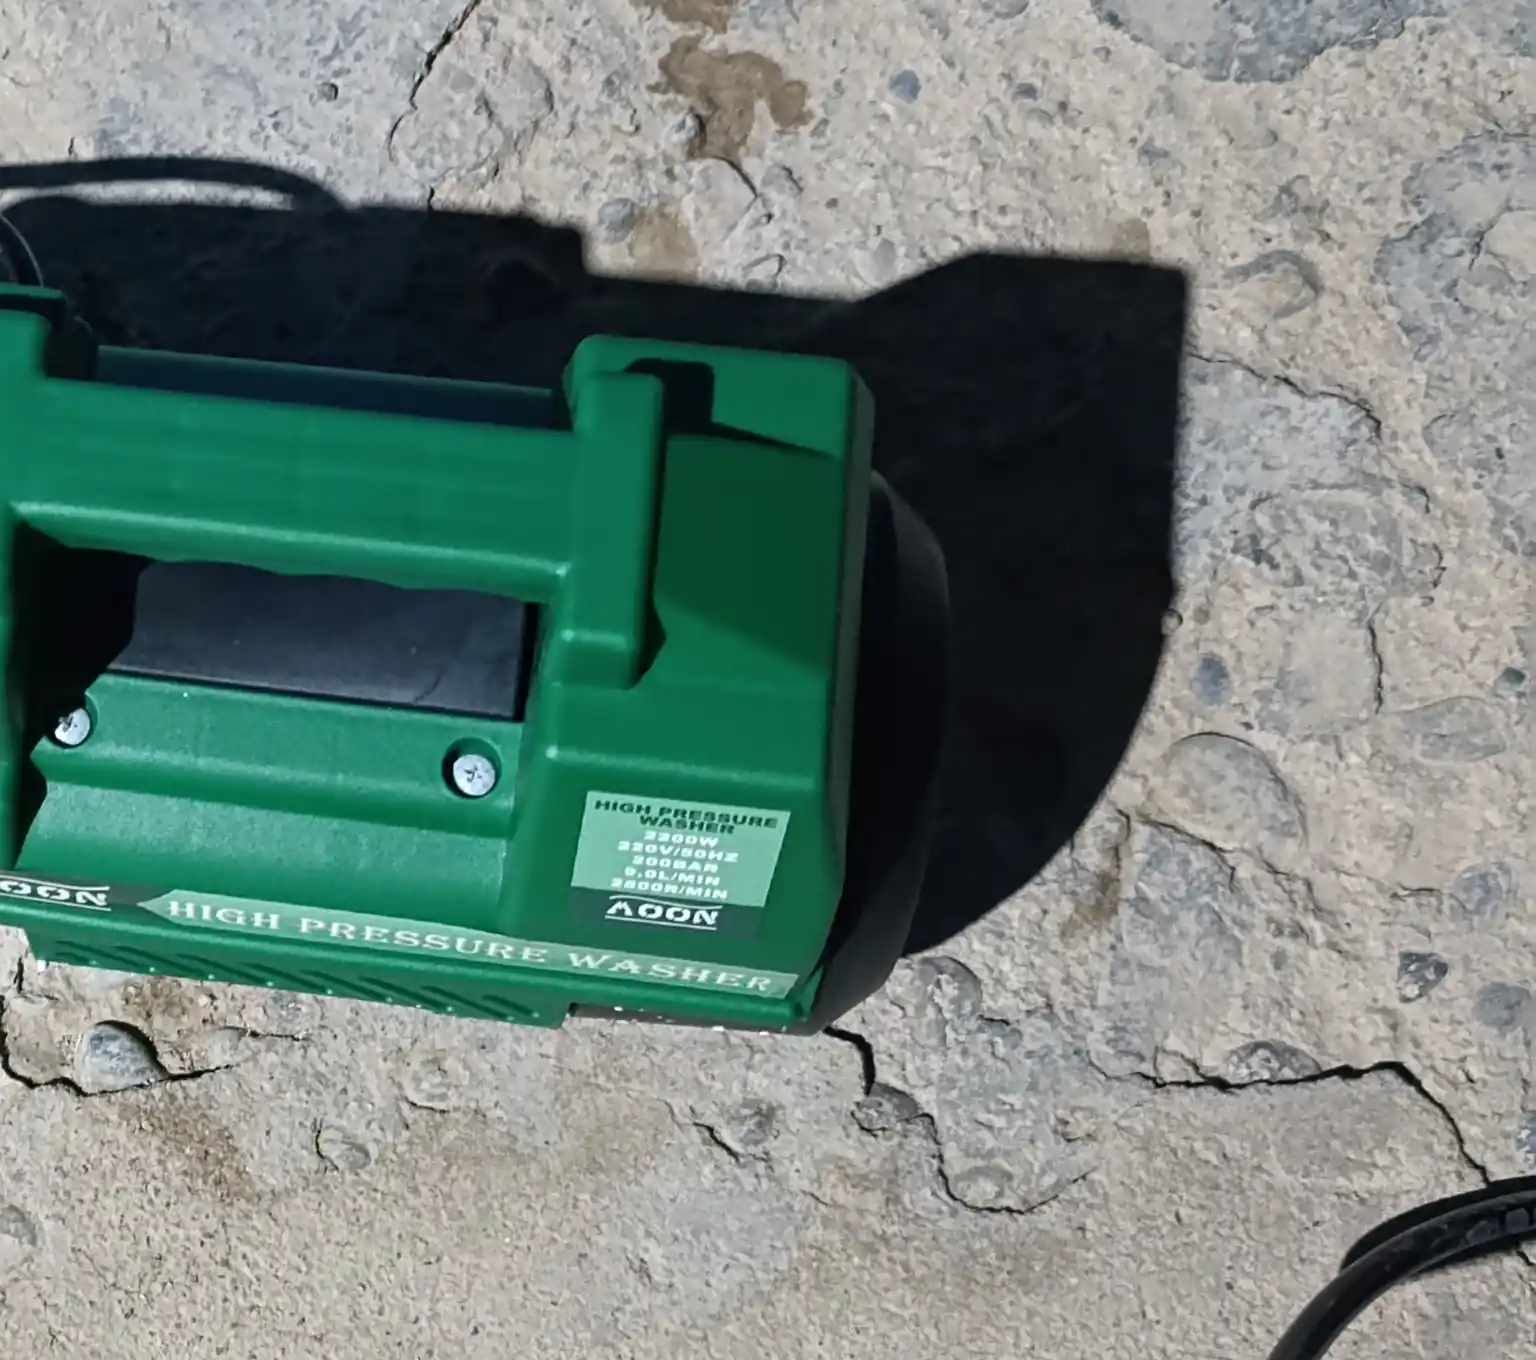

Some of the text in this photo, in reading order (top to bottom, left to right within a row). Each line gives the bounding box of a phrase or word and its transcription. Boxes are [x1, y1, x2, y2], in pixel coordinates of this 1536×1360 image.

[594, 799, 779, 829] HIGH PRESSURE
[639, 814, 735, 835] WASHER
[643, 830, 720, 848] 2200W
[616, 840, 740, 863] 220V/50HZ
[631, 855, 720, 874] 200BAR
[610, 877, 729, 900] 2800R/MIN
[606, 899, 720, 926] MOON
[167, 900, 773, 993] HIGH PRESSURE WASHER
